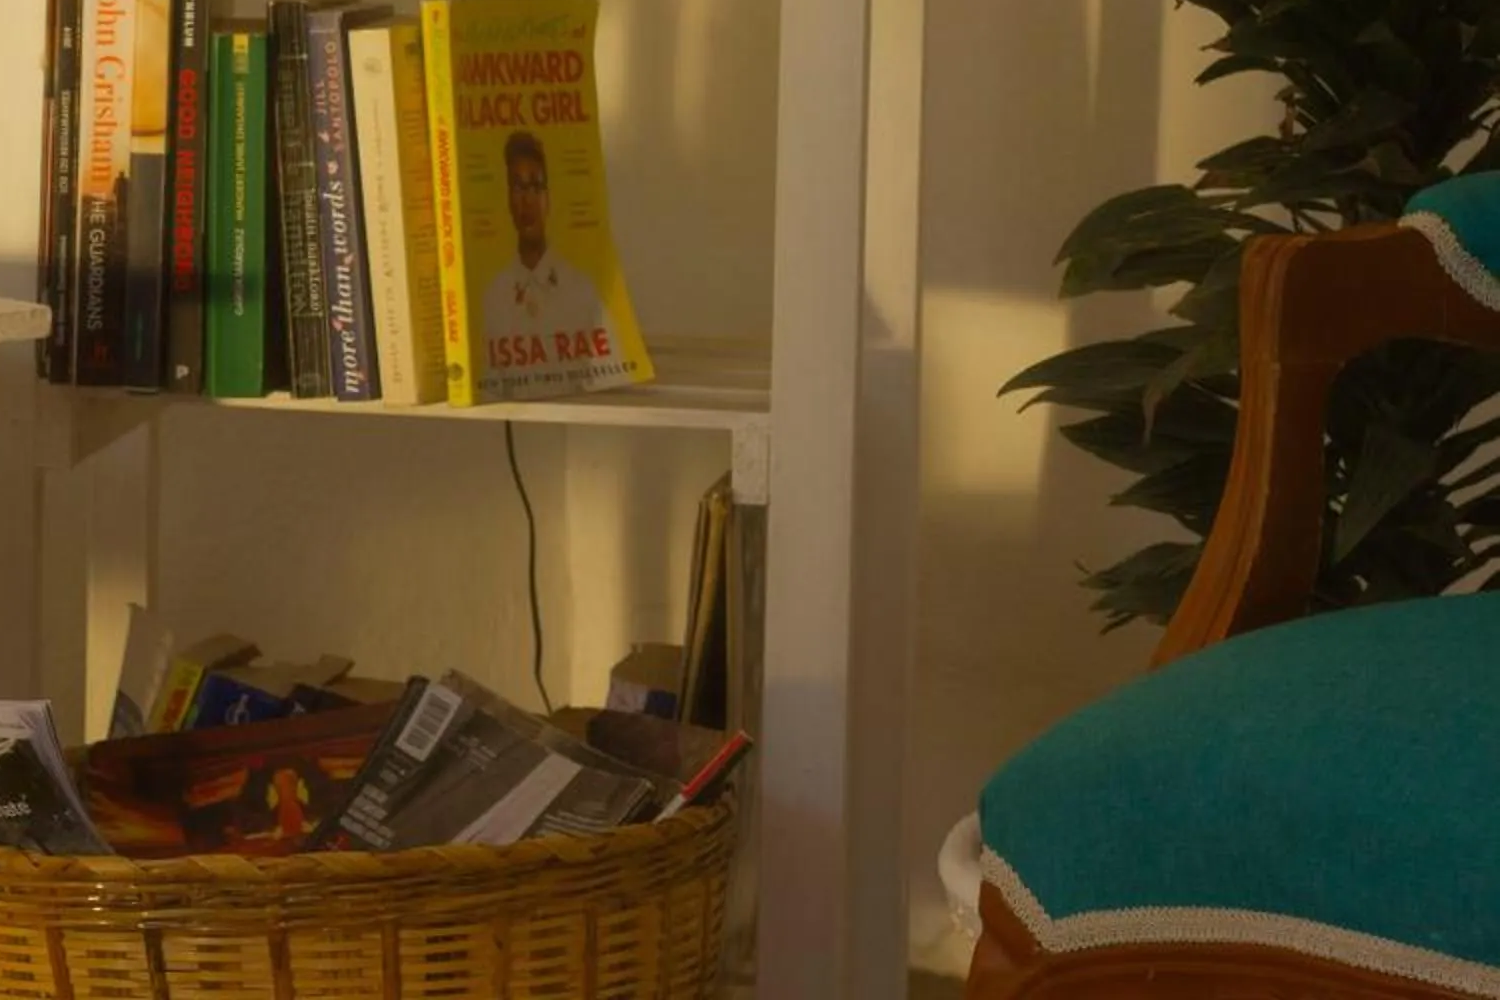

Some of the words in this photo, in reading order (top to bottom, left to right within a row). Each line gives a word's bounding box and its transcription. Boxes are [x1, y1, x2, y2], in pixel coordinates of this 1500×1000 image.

[91, 55, 125, 181] Grisham
[180, 69, 196, 138] GOOD
[316, 81, 326, 115] JILL
[531, 87, 591, 125] GIRL
[323, 180, 347, 253] words
[87, 229, 105, 330] GUARDIANS
[331, 265, 353, 323] than
[342, 330, 360, 392] more
[488, 334, 548, 369] ISSA
[555, 327, 613, 362] RAE
